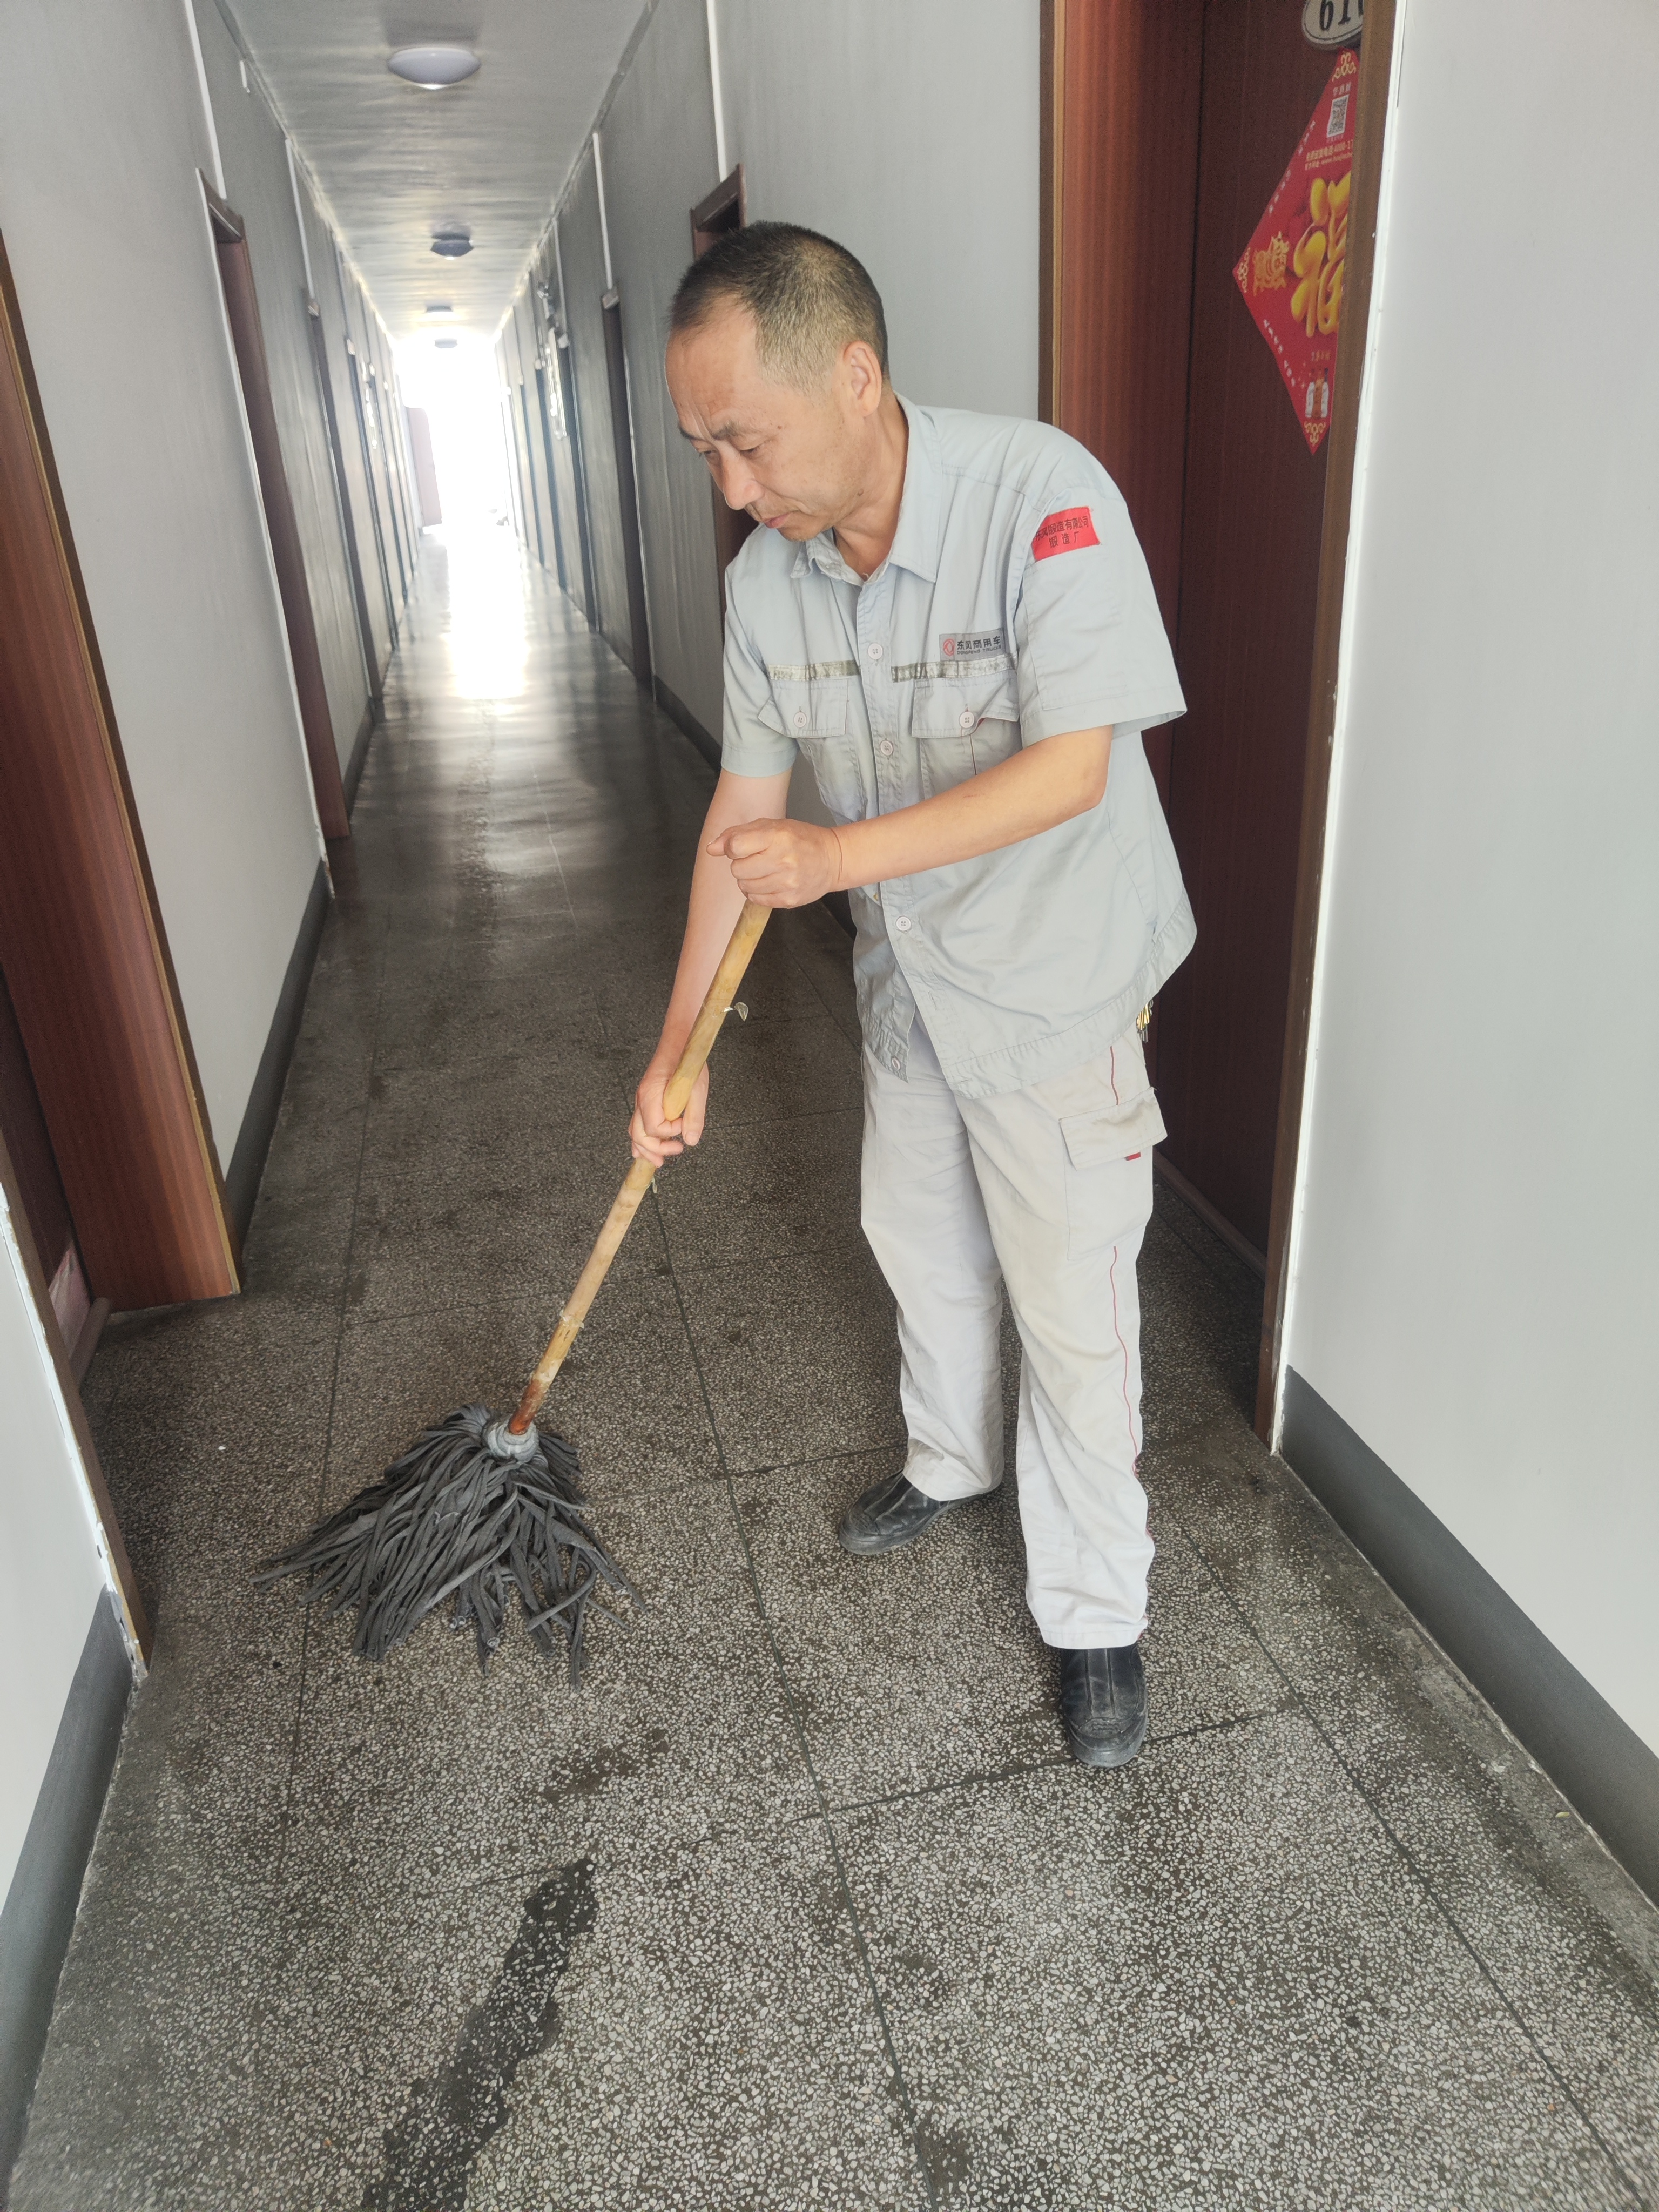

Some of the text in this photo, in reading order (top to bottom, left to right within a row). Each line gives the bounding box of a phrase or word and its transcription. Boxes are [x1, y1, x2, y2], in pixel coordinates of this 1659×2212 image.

[1049, 531, 1080, 548] 锻造厂
[957, 636, 1001, 650] 东风商用车
